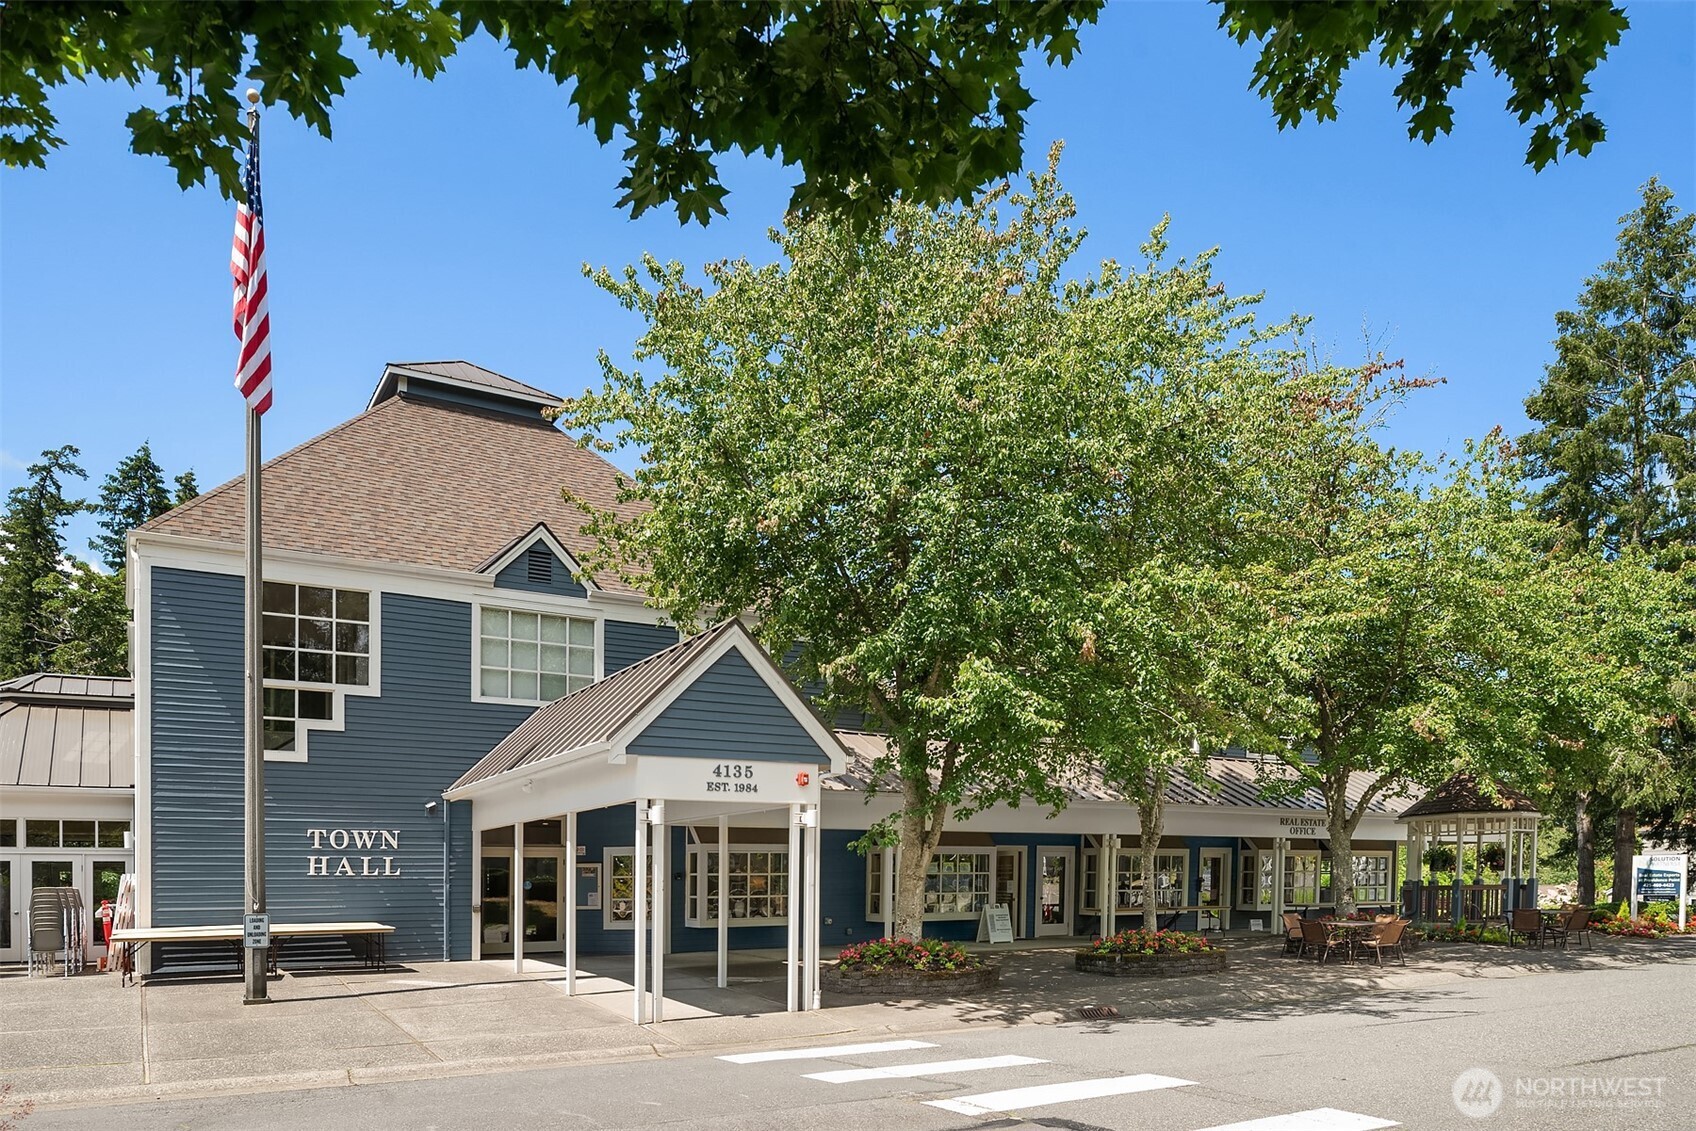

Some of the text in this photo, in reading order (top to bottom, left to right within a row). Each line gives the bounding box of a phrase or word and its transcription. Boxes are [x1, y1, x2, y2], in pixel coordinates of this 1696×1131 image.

[712, 764, 754, 779] 4135
[706, 782, 758, 793] EST. 1984
[1280, 818, 1326, 827] REAL ESTATE
[1290, 827, 1316, 835] OFFICE
[307, 829, 401, 850] TOWN
[307, 856, 401, 876] HALL
